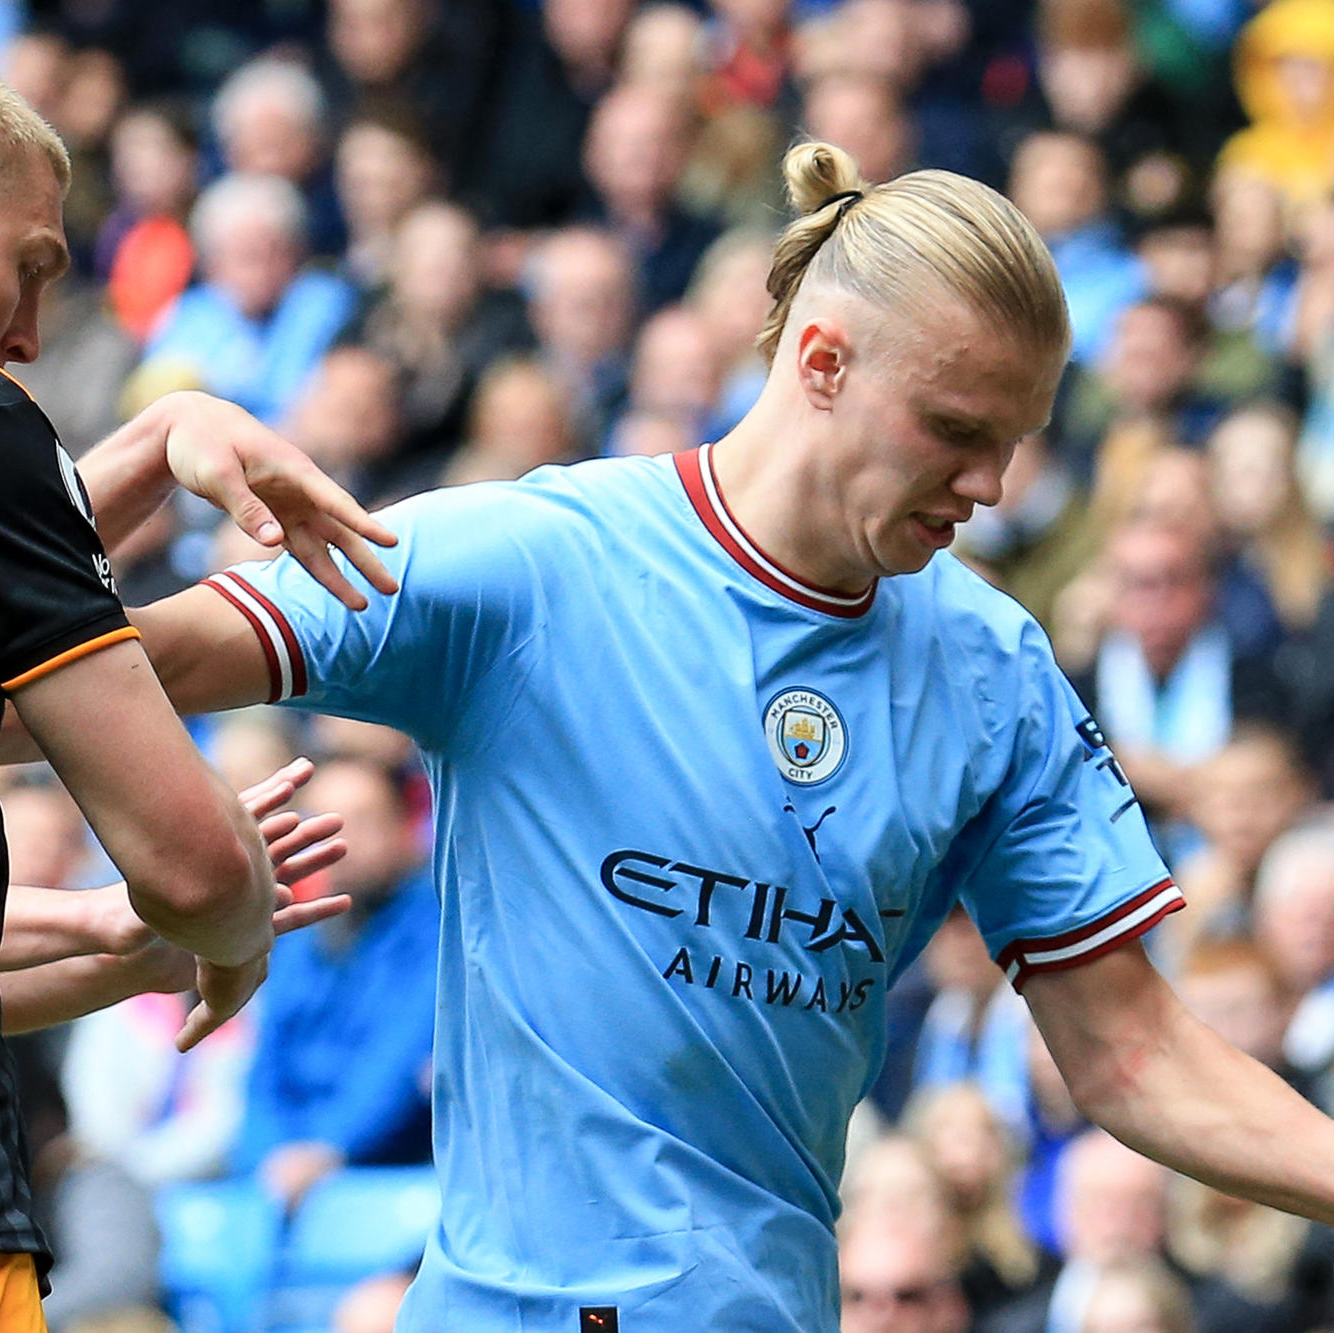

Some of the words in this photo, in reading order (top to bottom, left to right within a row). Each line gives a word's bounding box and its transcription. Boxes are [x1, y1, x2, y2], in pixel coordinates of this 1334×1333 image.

[771, 694, 838, 729] MANCHESTER
[788, 768, 813, 779] CITY
[600, 849, 905, 962] ETIHA
[663, 947, 874, 1013] AIRWAYS
